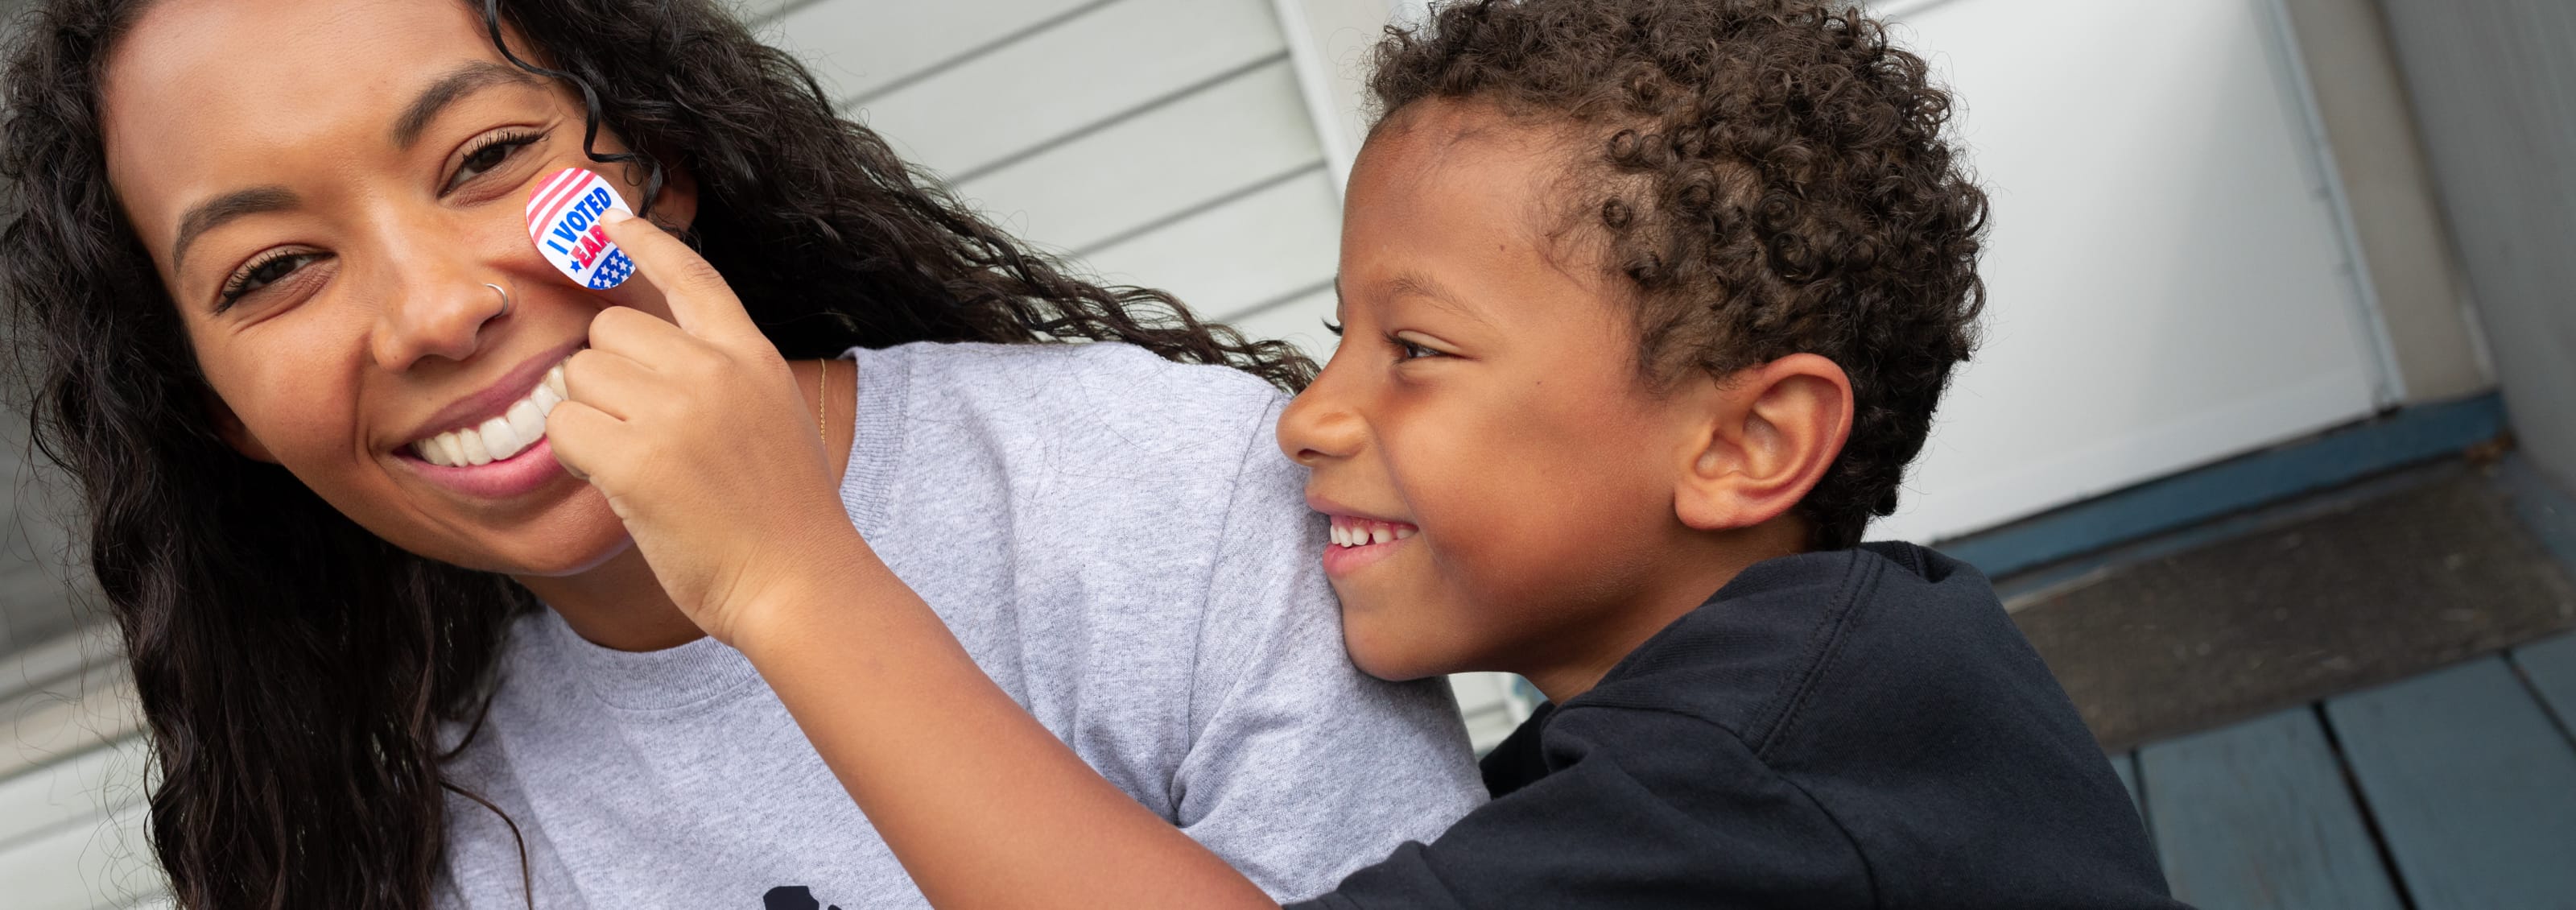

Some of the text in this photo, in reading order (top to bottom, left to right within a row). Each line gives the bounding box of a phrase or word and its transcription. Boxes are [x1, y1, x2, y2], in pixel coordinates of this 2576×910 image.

[547, 187, 612, 255] I VOTED
[571, 225, 612, 270] EAR
